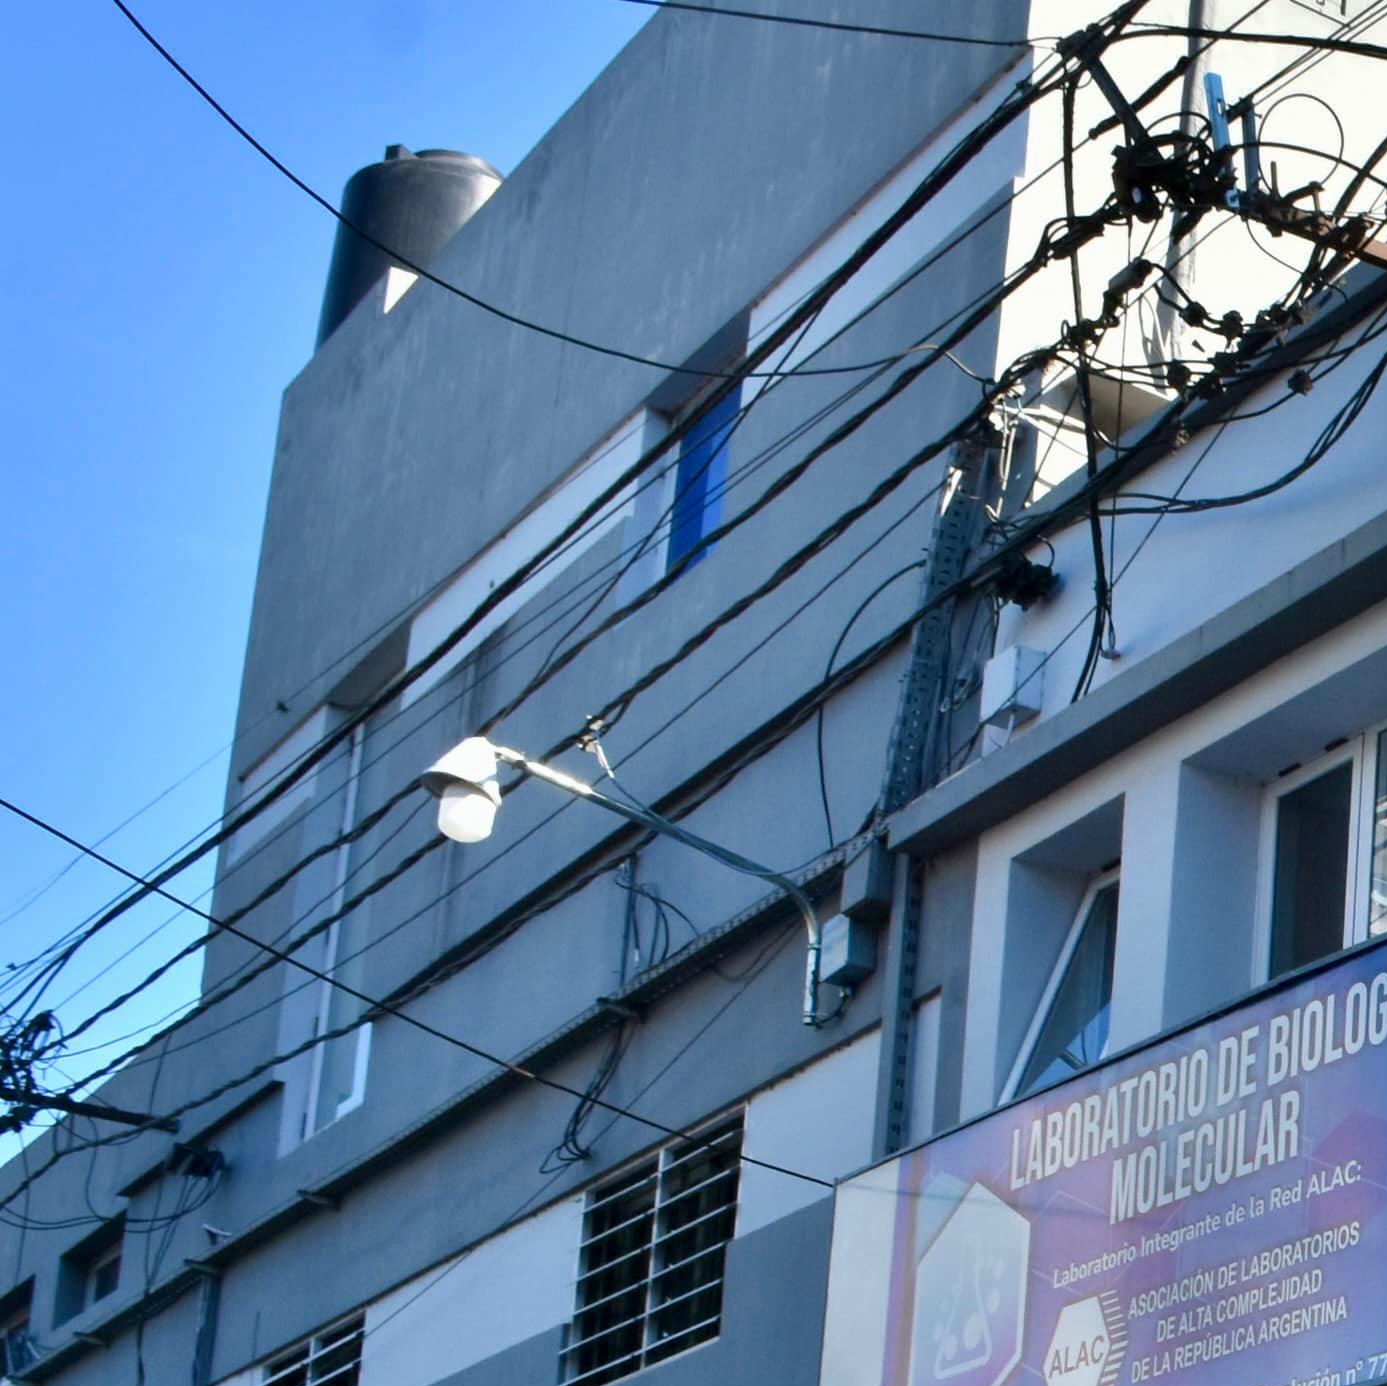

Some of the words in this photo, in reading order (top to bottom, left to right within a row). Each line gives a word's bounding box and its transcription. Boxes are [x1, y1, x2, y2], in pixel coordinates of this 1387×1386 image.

[1010, 1048, 1208, 1192] LABORATORIO
[1216, 1025, 1259, 1108] DE
[1110, 1090, 1299, 1225] MOLECULAR
[1053, 1244, 1136, 1288] Laboratorio
[1141, 1213, 1221, 1257] Integrante
[1225, 1203, 1244, 1227] de
[1249, 1196, 1264, 1218] la
[1270, 1181, 1301, 1211] Red
[1306, 1160, 1361, 1199] ALAC:
[1128, 1267, 1213, 1319] ASOCIACIÓN
[1218, 1262, 1237, 1288] DE
[1241, 1222, 1360, 1282] LABORATORIOS
[1131, 1359, 1149, 1384] DE
[1153, 1355, 1171, 1379] LA
[1174, 1327, 1254, 1371] REPÚBLICA
[1258, 1295, 1347, 1346] ARGENTINA
[1157, 1318, 1174, 1343] DE
[1177, 1310, 1213, 1339] ALTA
[1216, 1268, 1322, 1323] COMPLEJIDAD
[1049, 1334, 1106, 1379] ALAC
